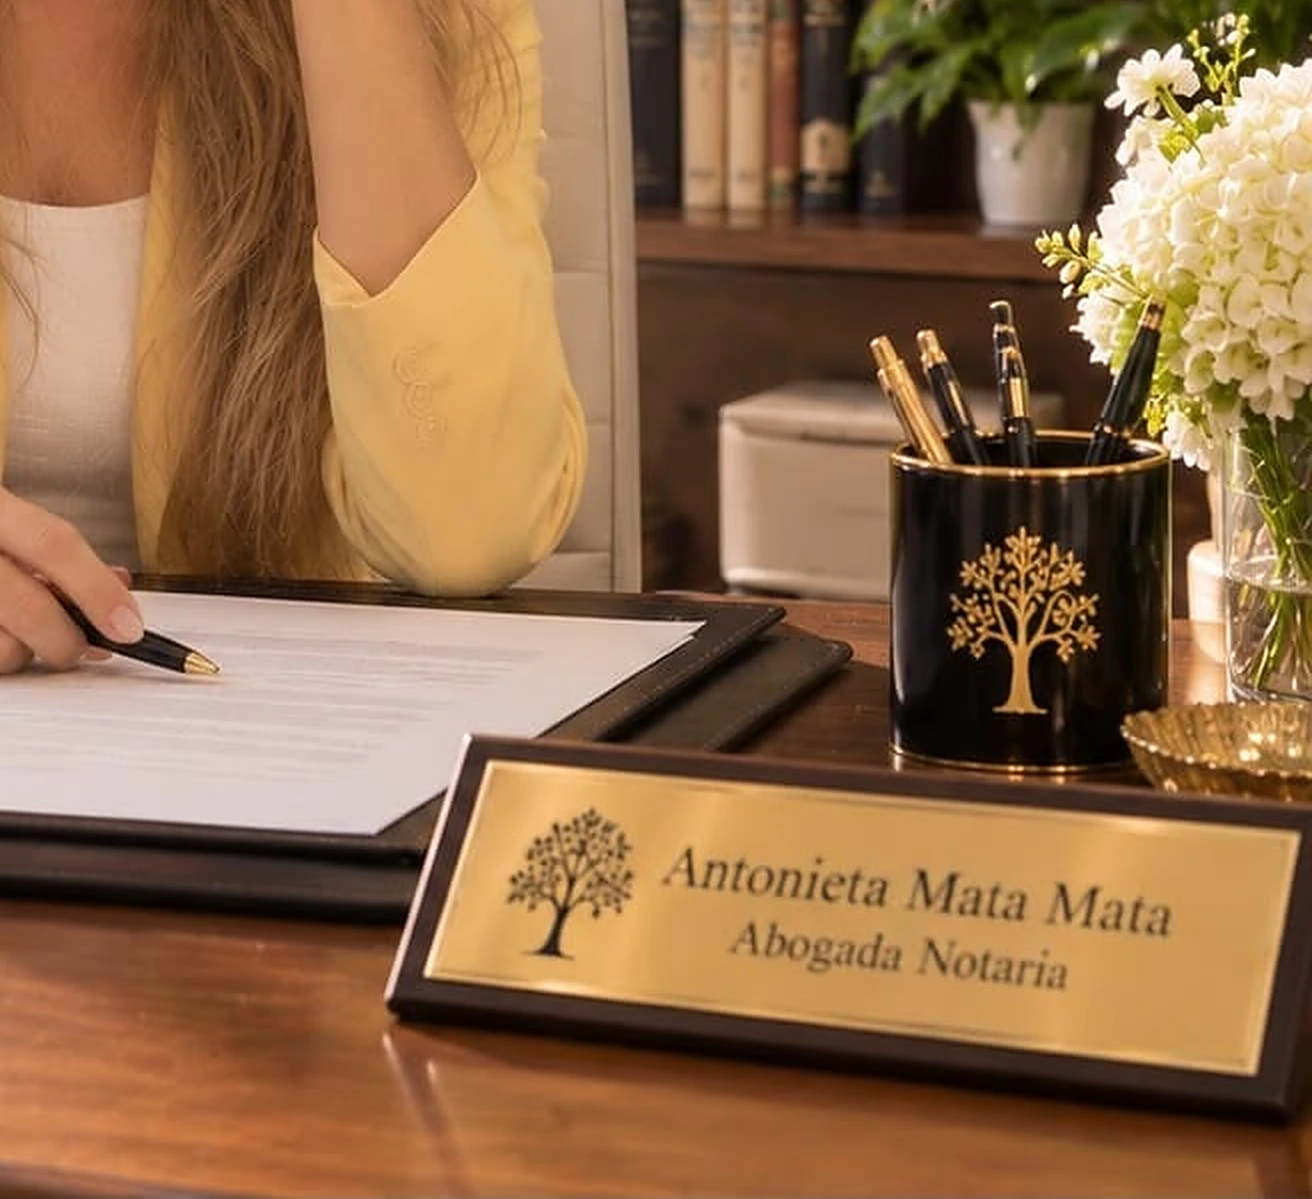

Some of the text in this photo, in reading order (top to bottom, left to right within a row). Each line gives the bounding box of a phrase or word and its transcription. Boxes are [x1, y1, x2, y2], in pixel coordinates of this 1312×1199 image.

[661, 845, 1173, 938] Antonieta Mata Mata
[728, 919, 1069, 991] Abogada Notaria
